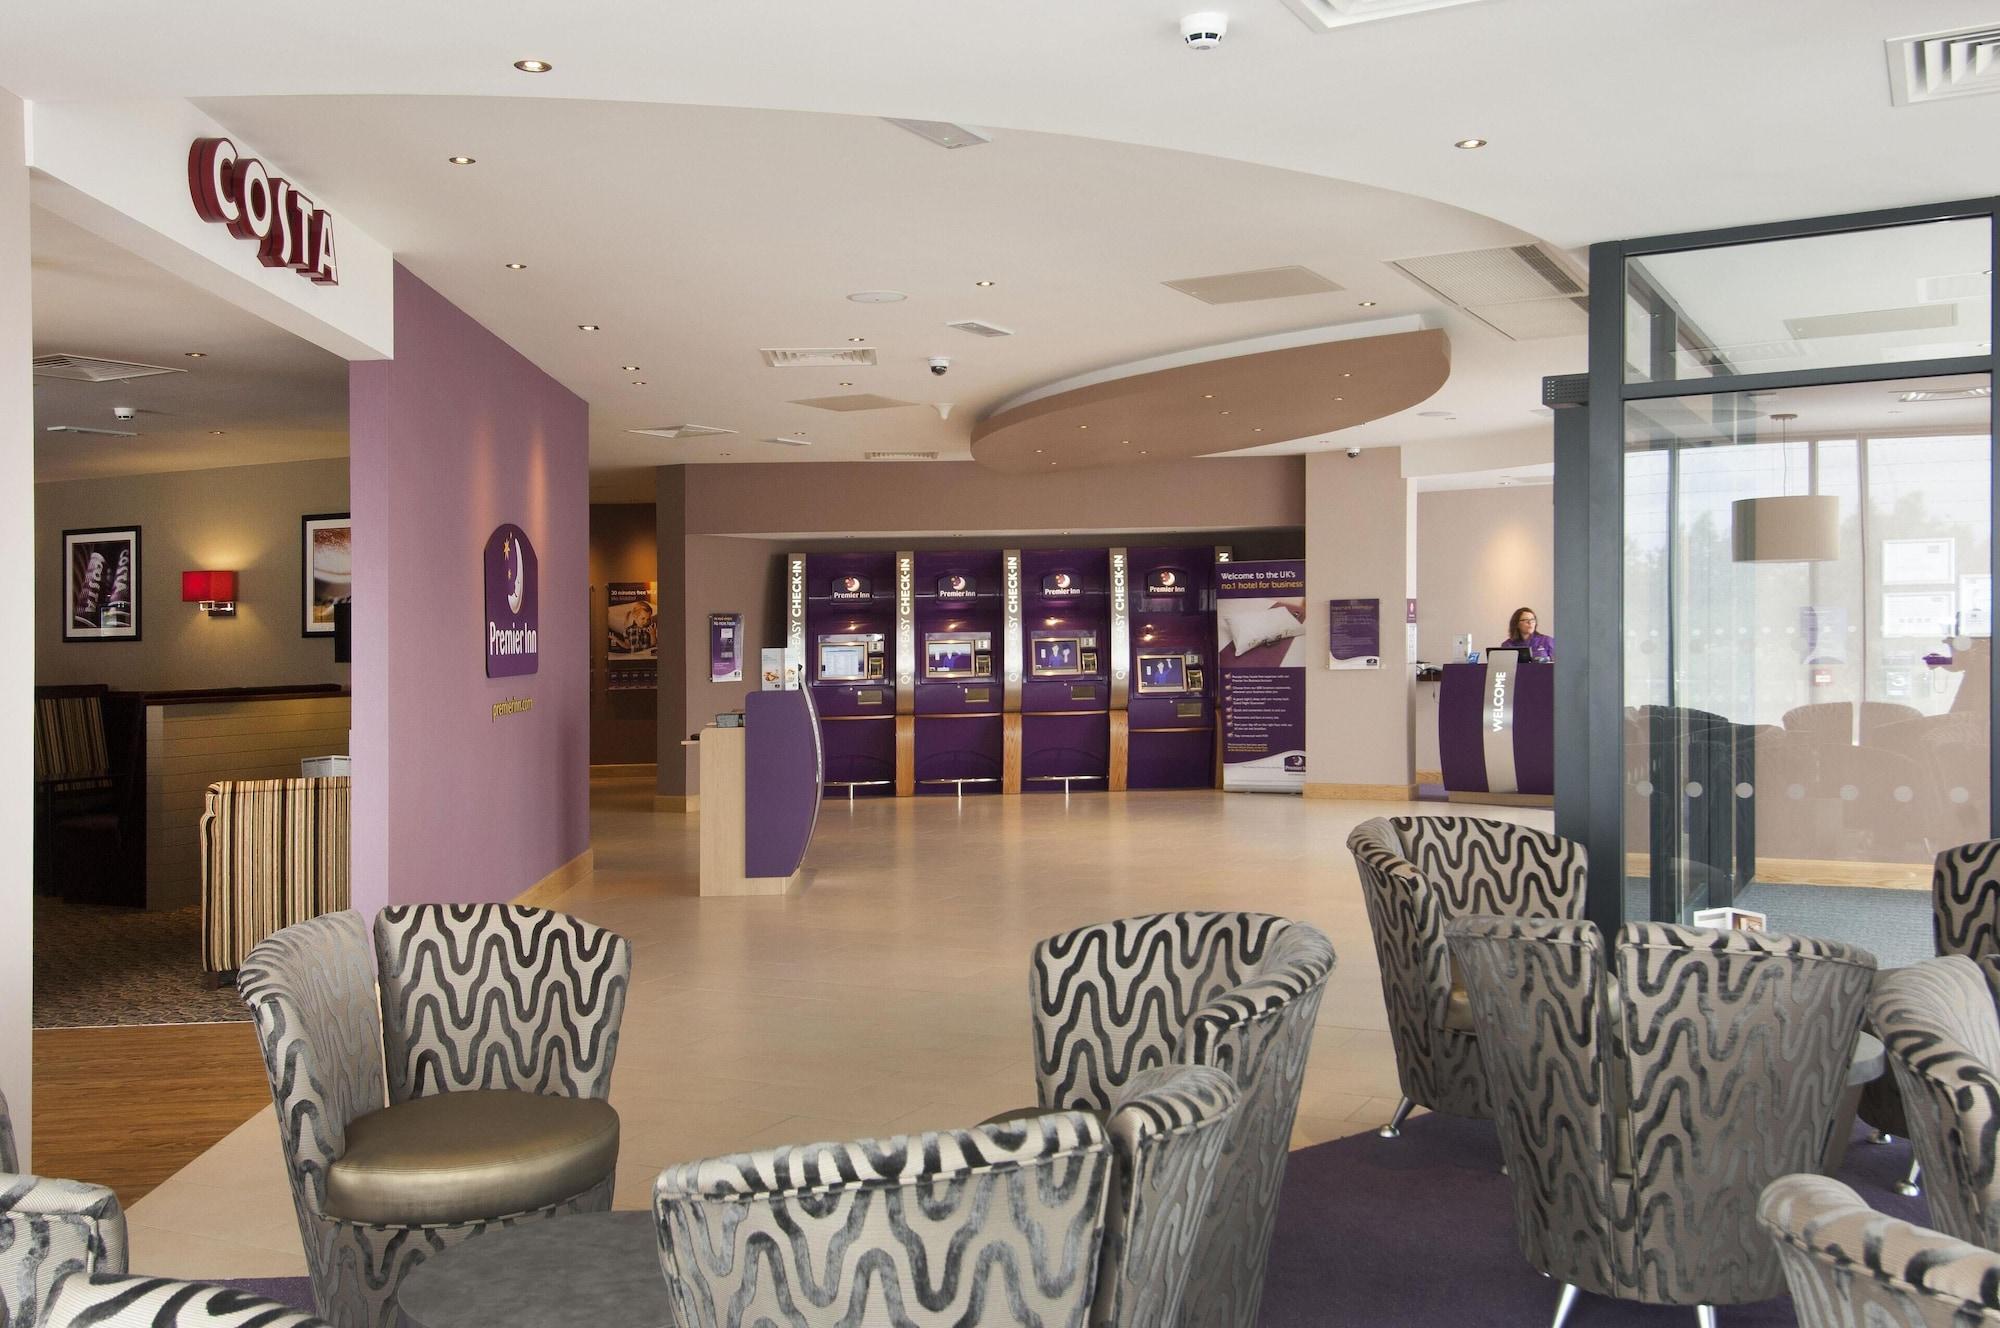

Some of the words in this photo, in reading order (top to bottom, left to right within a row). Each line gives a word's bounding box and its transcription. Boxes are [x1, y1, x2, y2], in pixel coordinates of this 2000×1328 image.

[188, 137, 339, 286] COSTA
[792, 560, 802, 617] CHECK-IN
[833, 591, 859, 599] Premier
[901, 558, 911, 615] CHECK-IN
[1007, 556, 1018, 613] CHECK-IN
[1113, 554, 1125, 611] CHECK-IN
[1221, 572, 1254, 580] Welcome
[1266, 570, 1278, 578] the
[1279, 570, 1296, 578] UK's
[1221, 582, 1236, 590] no.1
[1238, 581, 1257, 589] hotel
[1259, 580, 1270, 588] for
[1272, 580, 1303, 588] business
[490, 621, 524, 656] Premier
[524, 622, 537, 654] Inn
[492, 696, 534, 723] premierinn.com
[1493, 672, 1506, 732] WELCOME
